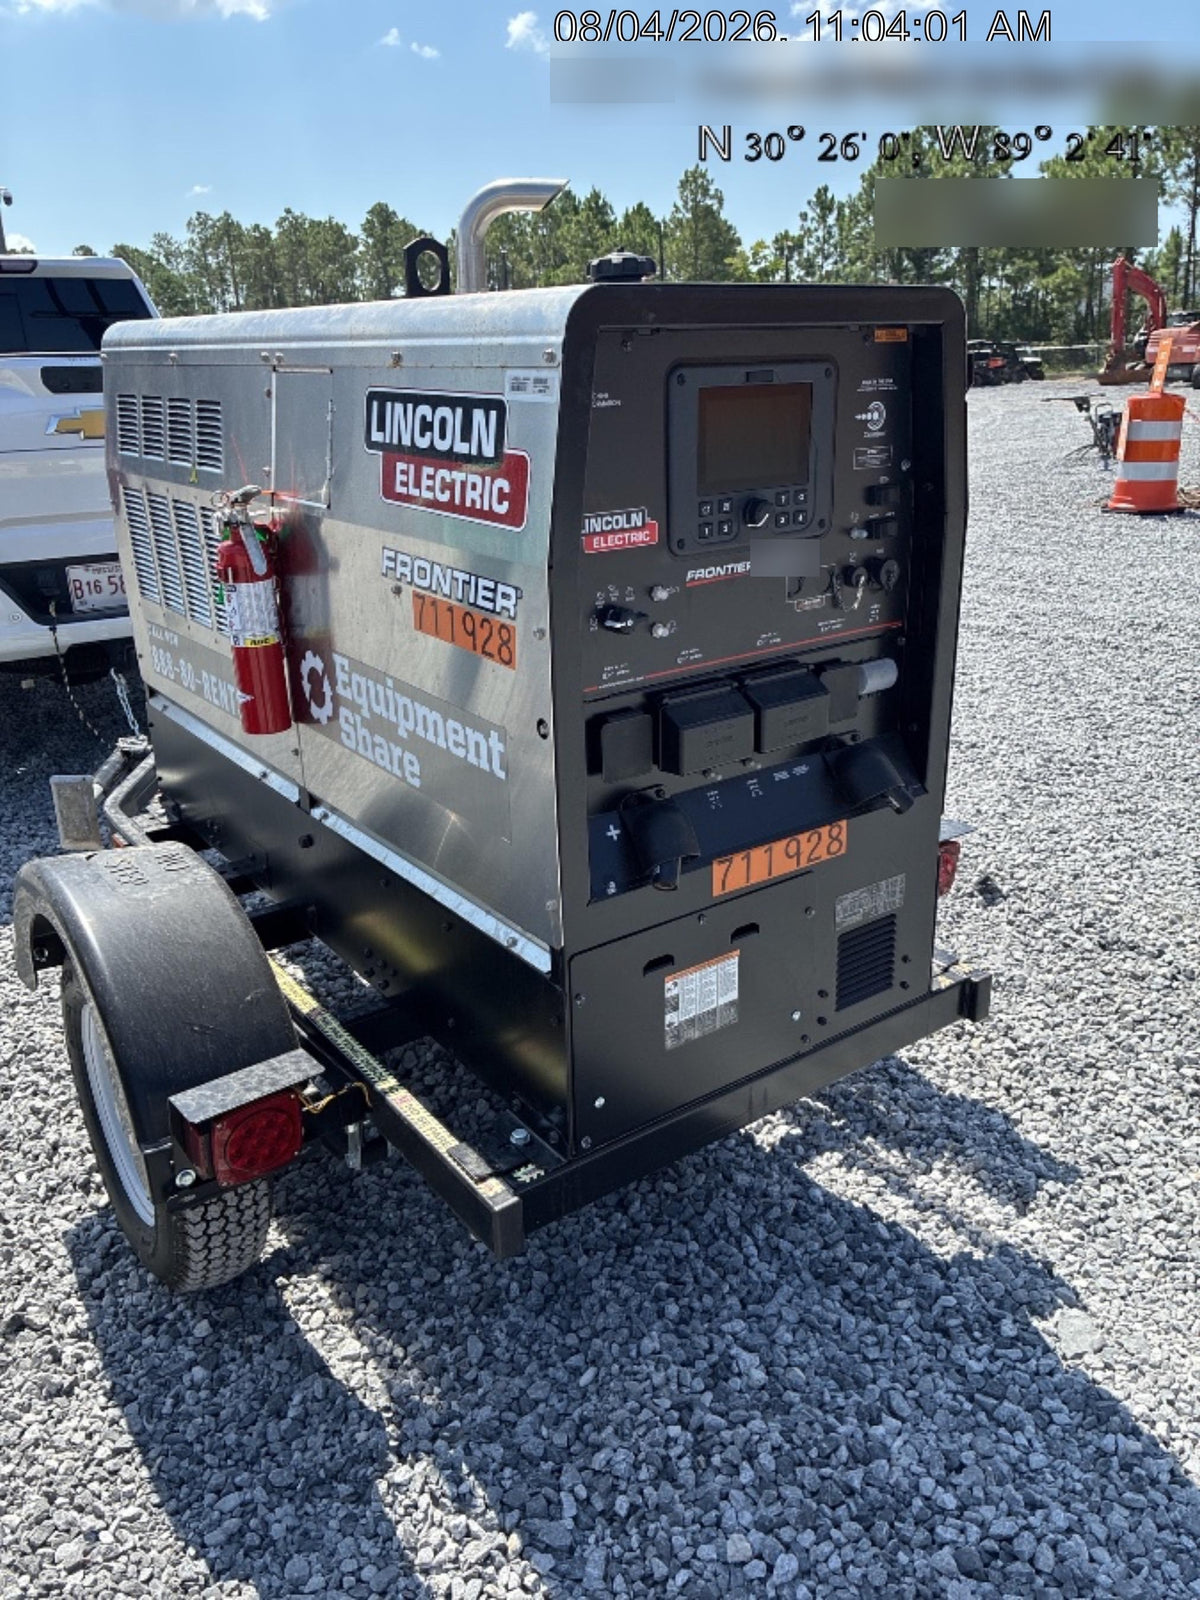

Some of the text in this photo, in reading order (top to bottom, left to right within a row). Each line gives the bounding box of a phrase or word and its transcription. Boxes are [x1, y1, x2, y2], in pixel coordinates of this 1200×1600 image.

[370, 399, 497, 458] LINCOLN
[394, 460, 511, 515] ELECTRIC
[593, 530, 651, 549] ELECTRIC
[382, 547, 522, 620] FRONTIER
[412, 594, 514, 667] 711928
[332, 652, 506, 781] Equipment
[338, 705, 422, 789] Share
[716, 822, 844, 892] 711928
